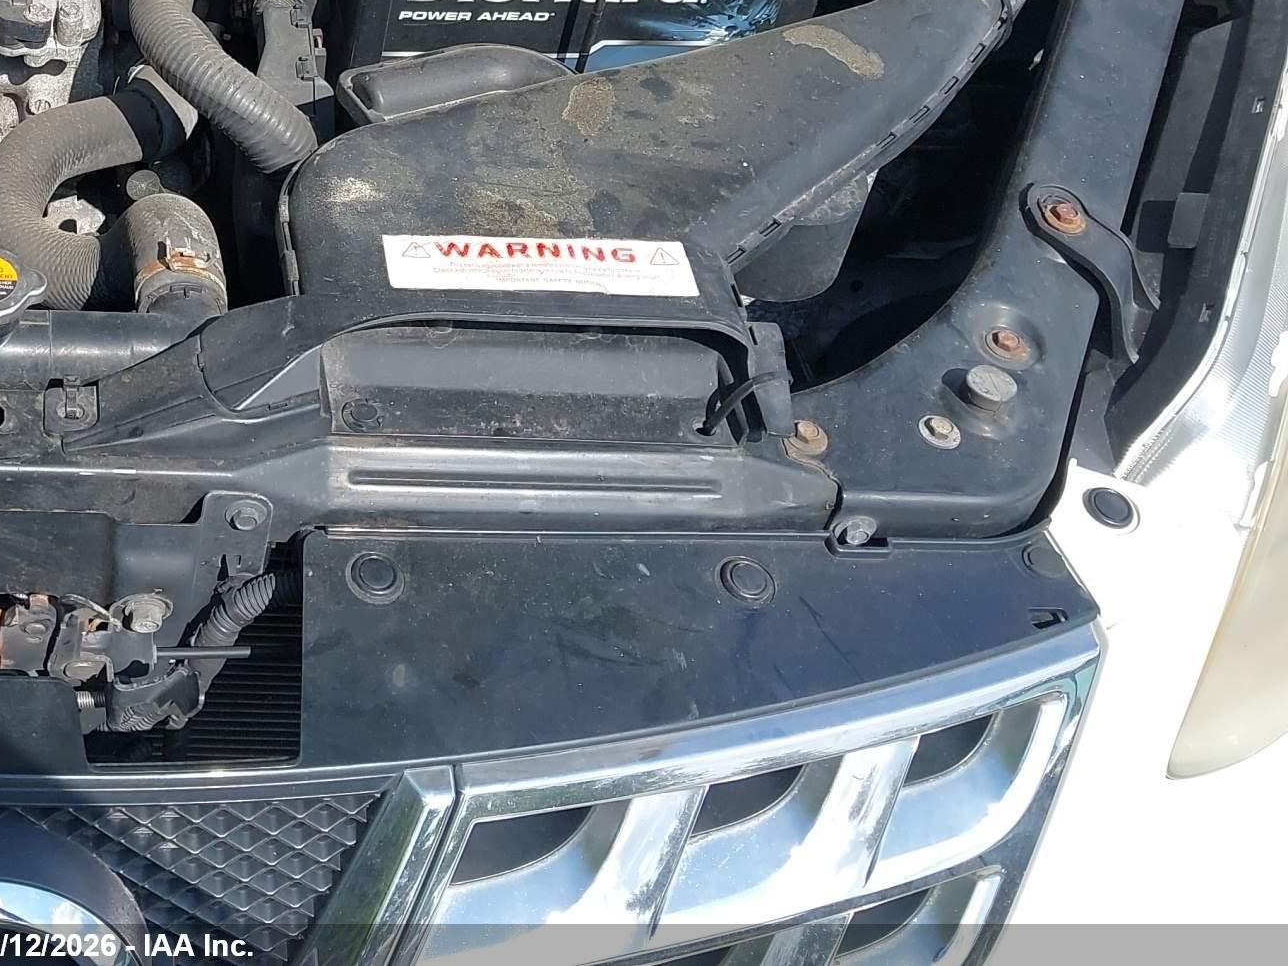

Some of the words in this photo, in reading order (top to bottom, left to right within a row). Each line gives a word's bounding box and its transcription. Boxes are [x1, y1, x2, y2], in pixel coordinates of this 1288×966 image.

[398, 10, 472, 21] POWER
[477, 11, 550, 22] AHEAD
[434, 241, 636, 263] WARNING
